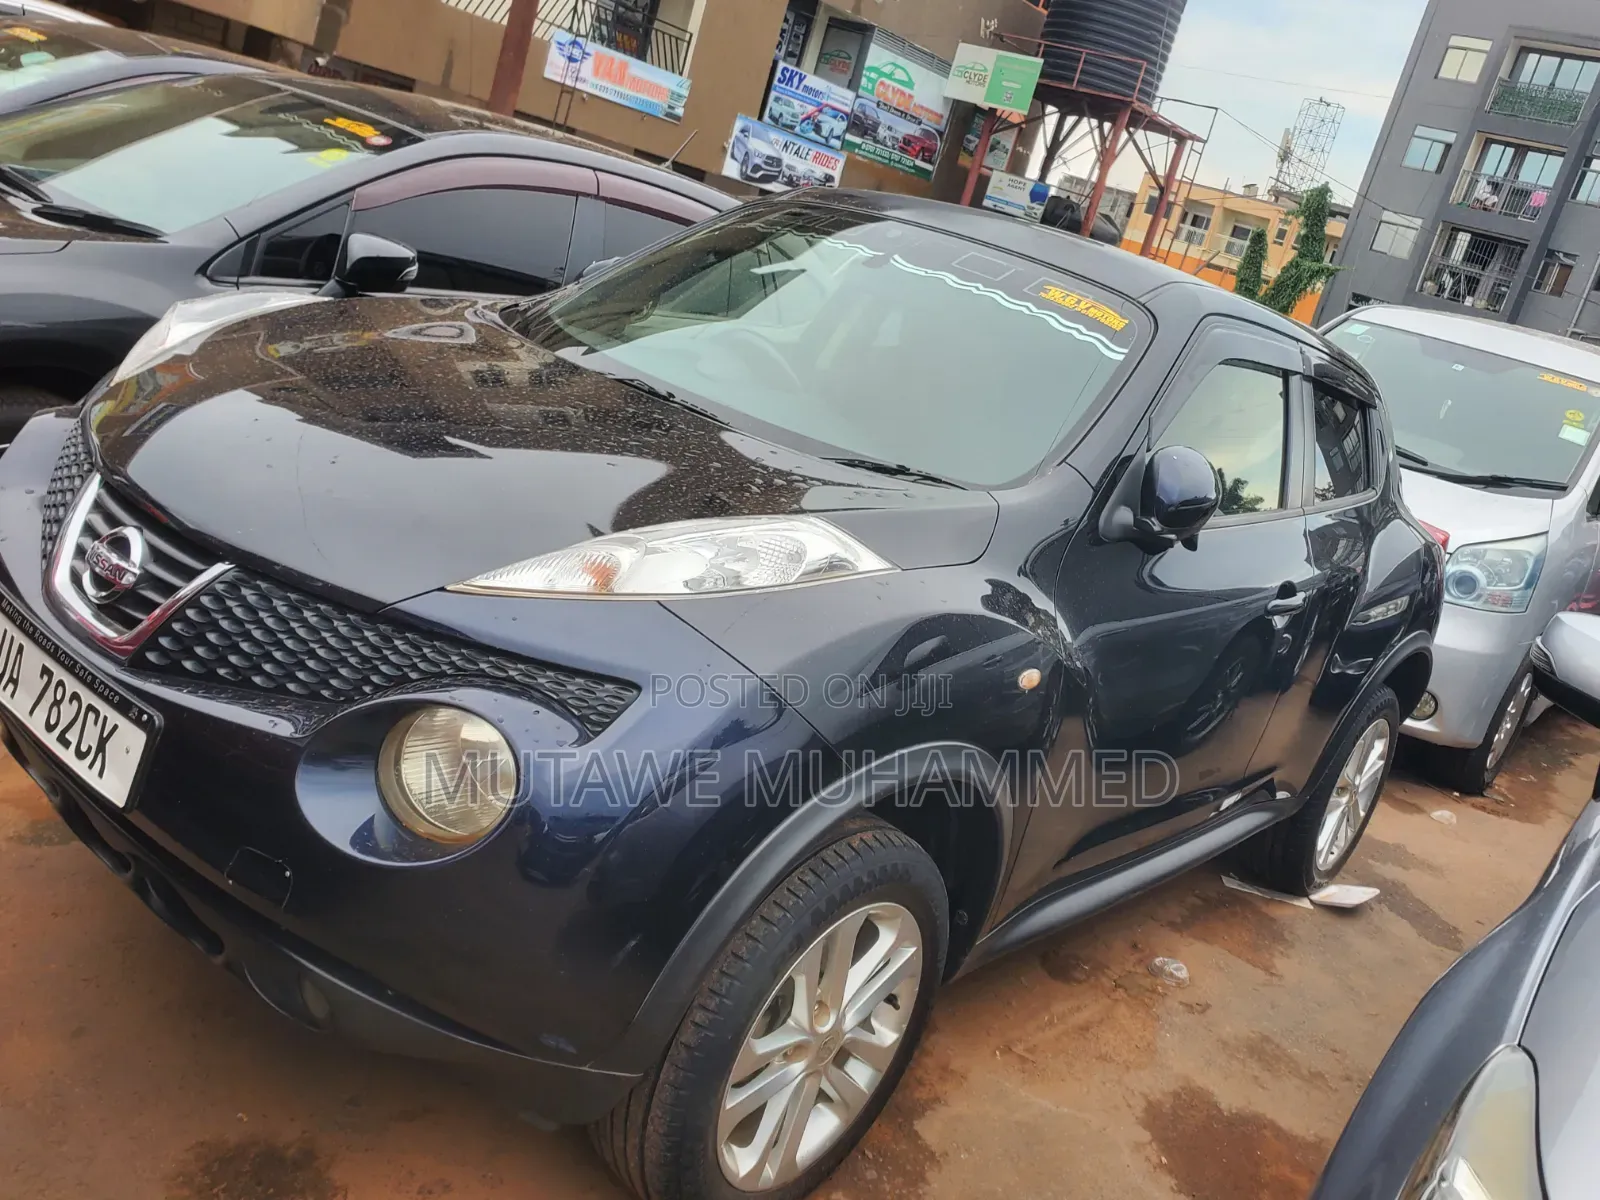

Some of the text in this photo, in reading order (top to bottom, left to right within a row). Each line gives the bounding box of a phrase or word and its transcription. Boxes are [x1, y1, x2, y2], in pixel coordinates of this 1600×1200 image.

[777, 65, 808, 91] SKY
[802, 85, 826, 101] motors
[963, 70, 989, 83] CLYDE
[965, 79, 987, 89] MOTORS
[782, 139, 811, 161] NTALE
[811, 150, 840, 171] RIDES
[1007, 183, 1026, 193] AGENT
[1008, 177, 1027, 188] HOPE
[1088, 306, 1127, 328] MOTORS
[88, 548, 126, 582] NISSAN
[1, 598, 120, 704] Making the Roads Your Safe Space
[28, 663, 119, 780] 782CK
